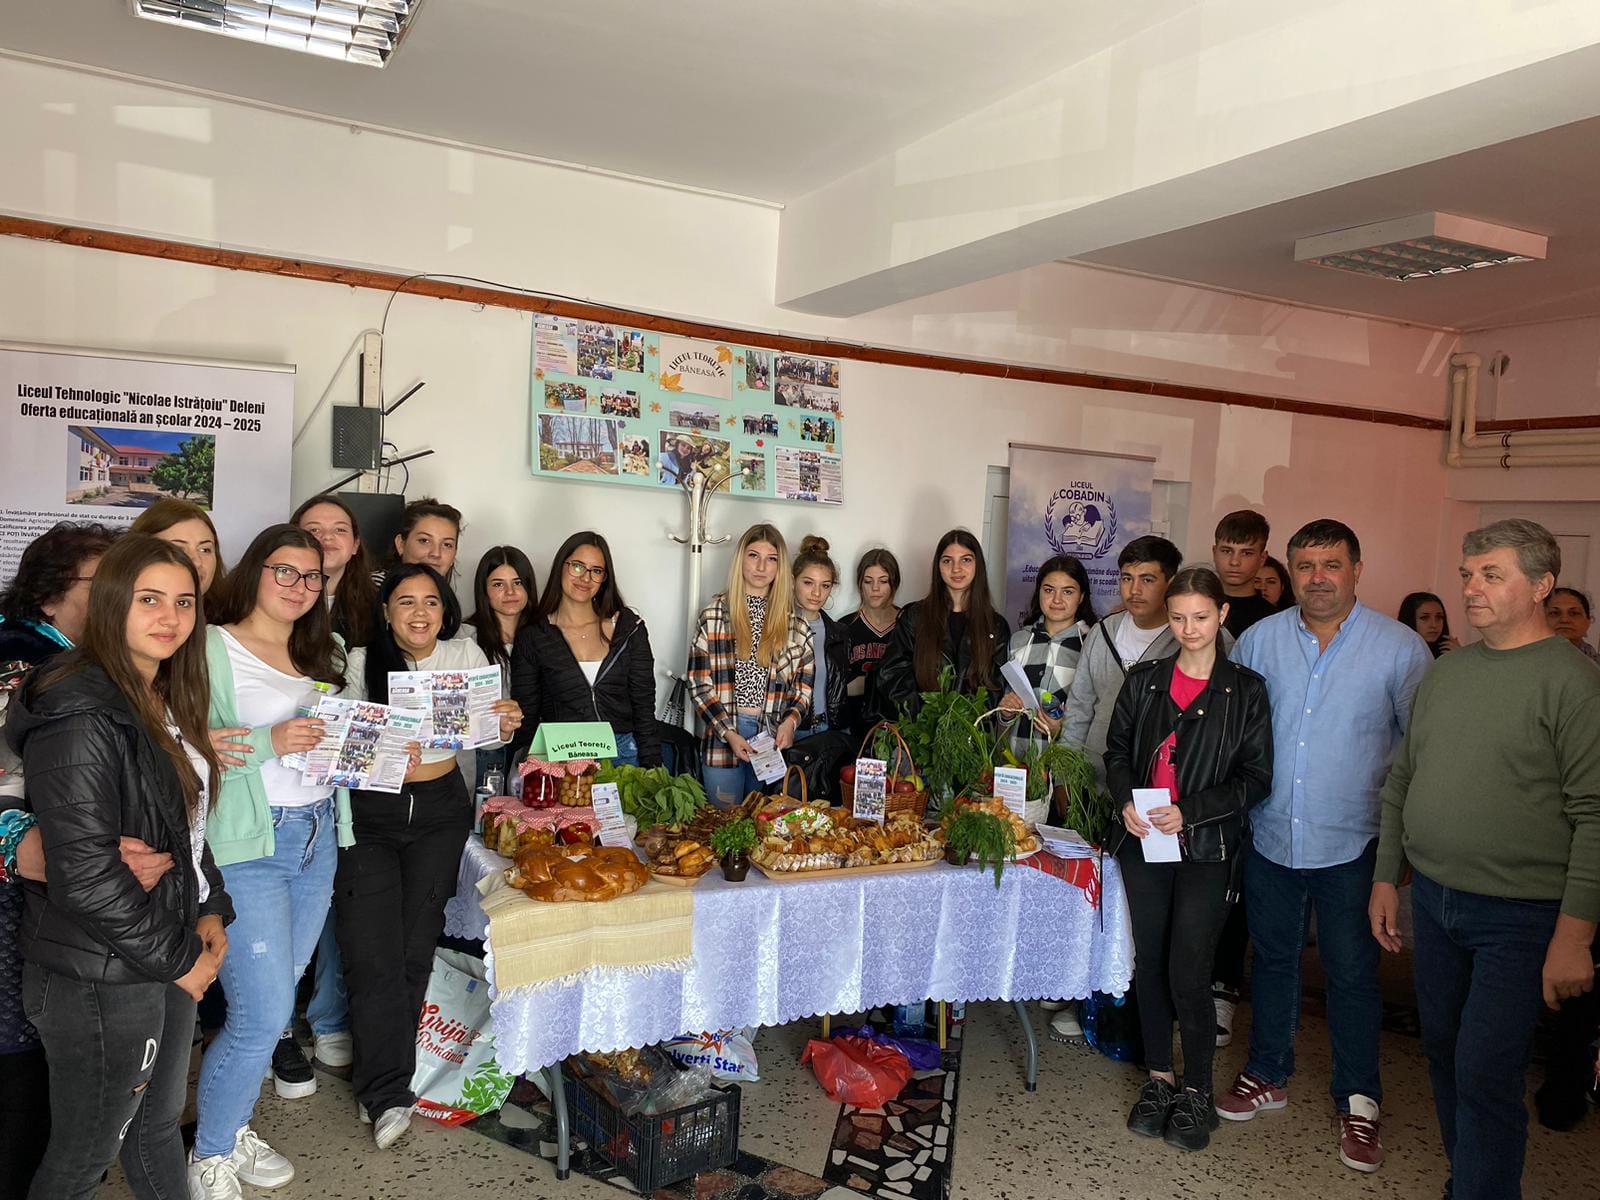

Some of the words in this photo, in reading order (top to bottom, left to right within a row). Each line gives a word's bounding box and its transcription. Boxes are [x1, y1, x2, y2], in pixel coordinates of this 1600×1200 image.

[17, 383, 52, 399] Liceul
[55, 386, 121, 405] Tehnologic
[123, 391, 171, 407] "Nicolae
[229, 399, 265, 414] Deleni
[20, 402, 57, 417] Oferta
[59, 405, 137, 424] educațională
[139, 412, 153, 424] an
[155, 413, 192, 428] școlar
[194, 414, 222, 429] 2024
[233, 417, 261, 432] 2025
[1070, 480, 1094, 489] LICEUL
[1059, 489, 1105, 502] COBADIN
[551, 741, 577, 753] Liceul
[578, 740, 612, 751] Teoretic
[713, 1056, 745, 1073] Star
